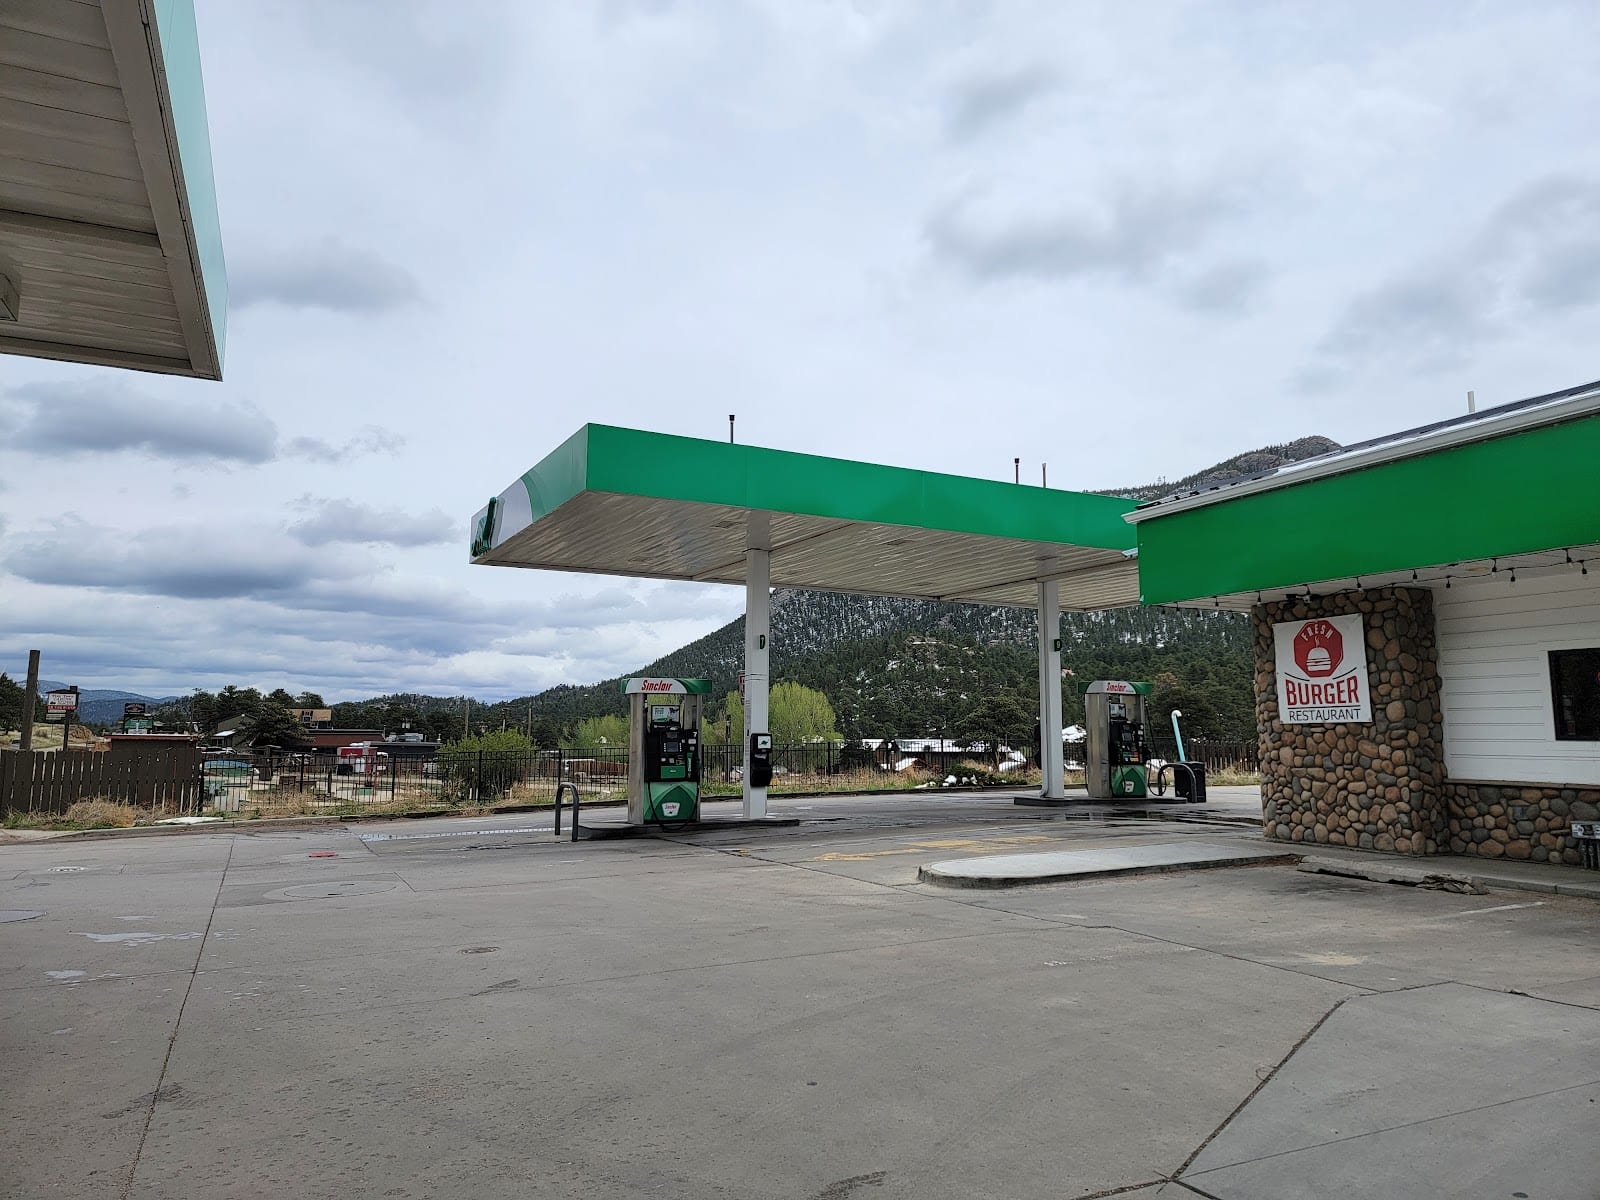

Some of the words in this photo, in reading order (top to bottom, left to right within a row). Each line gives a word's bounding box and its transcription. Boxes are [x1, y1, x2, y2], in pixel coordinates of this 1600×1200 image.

[1301, 623, 1334, 641] FRESH
[641, 679, 673, 692] Sinclair
[1285, 675, 1360, 706] BURGER
[1289, 708, 1361, 721] RESTAURANT
